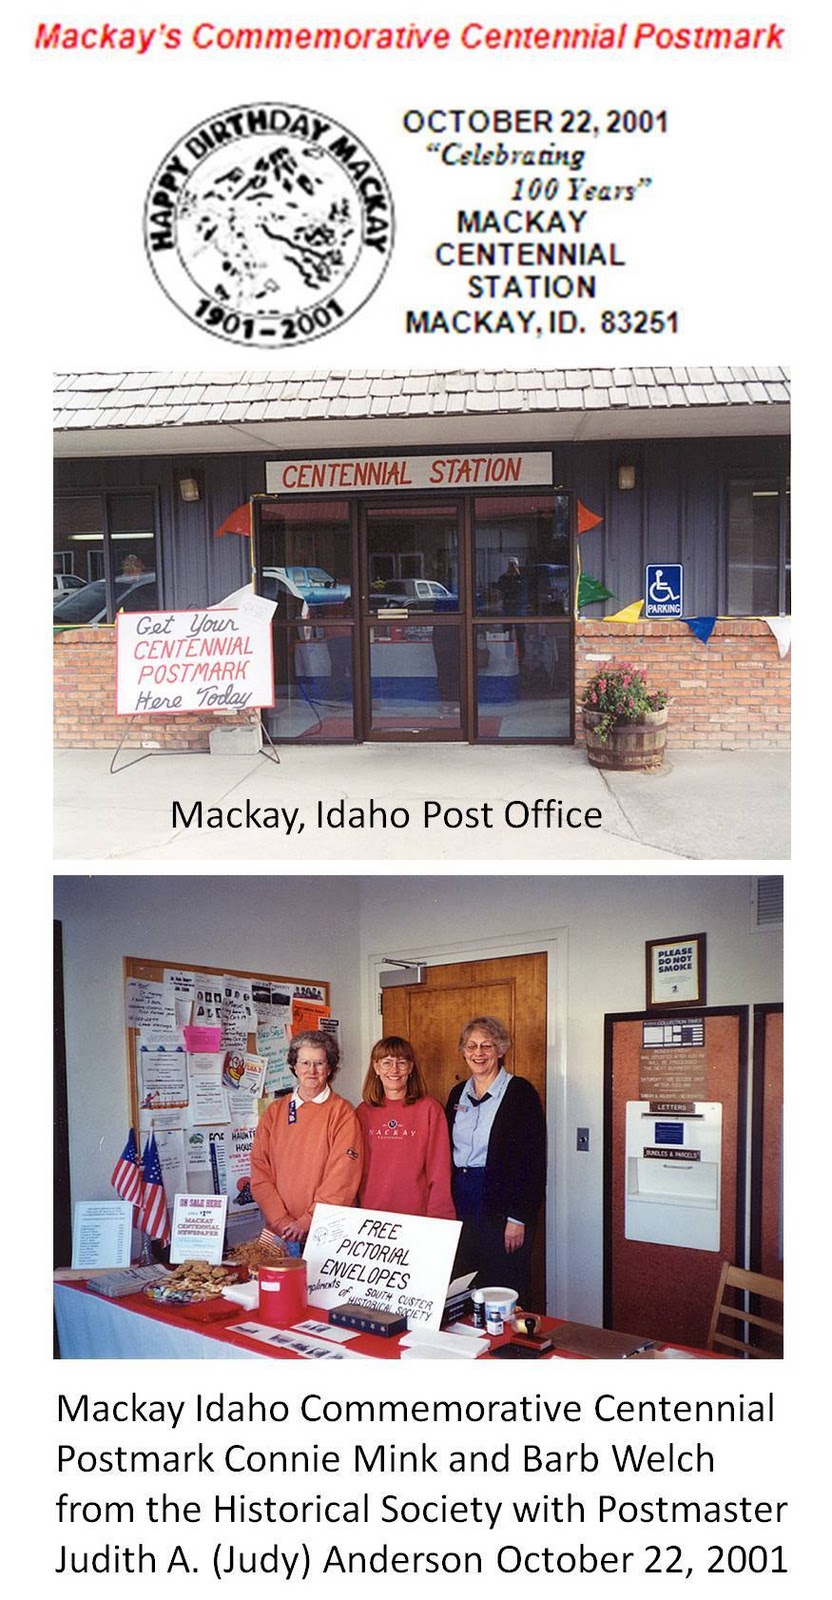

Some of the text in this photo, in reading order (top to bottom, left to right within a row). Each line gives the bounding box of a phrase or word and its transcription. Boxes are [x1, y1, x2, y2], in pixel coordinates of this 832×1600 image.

[282, 457, 522, 488] CENTENNIAL STATION
[648, 604, 681, 614] PARKING
[136, 613, 239, 638] Get Your
[134, 637, 253, 660] CENTENNIAL
[138, 660, 250, 685] POSTMARK
[135, 684, 253, 711] Here Today
[658, 947, 693, 958] PLEASE
[658, 955, 692, 966] DO NOT
[658, 963, 693, 973] SMOKE
[189, 1198, 205, 1208] SALE
[206, 1199, 222, 1208] HERE
[358, 1218, 403, 1240] FREE
[336, 1239, 410, 1266] PICTORIAL
[320, 1258, 411, 1290] ENVELOPES
[338, 1286, 353, 1297] of
[365, 1287, 434, 1310] SOUTH CUSTER
[347, 1296, 392, 1313] HISTORICAL
[396, 1306, 433, 1322] SOCIETY
